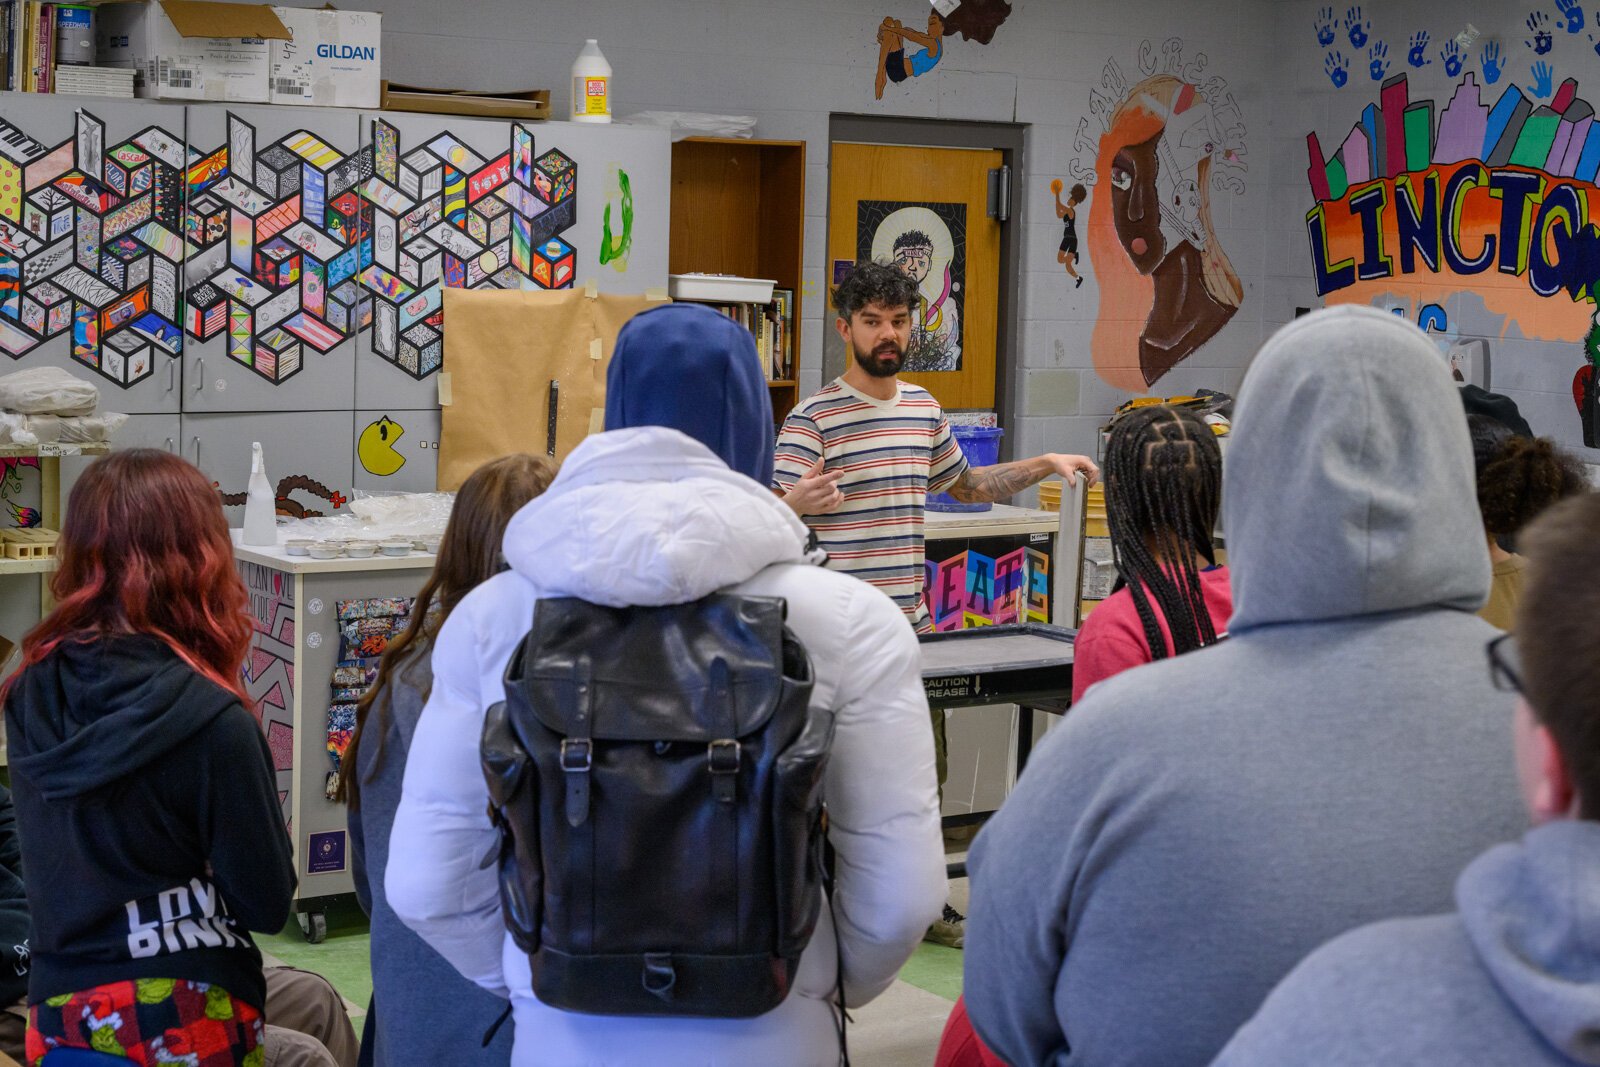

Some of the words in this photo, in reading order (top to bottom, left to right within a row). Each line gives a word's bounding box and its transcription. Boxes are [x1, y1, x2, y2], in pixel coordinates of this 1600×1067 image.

[317, 44, 376, 60] GILDAN
[922, 677, 969, 688] CAUTION
[925, 687, 969, 698] REASE!
[124, 877, 229, 934] LOV
